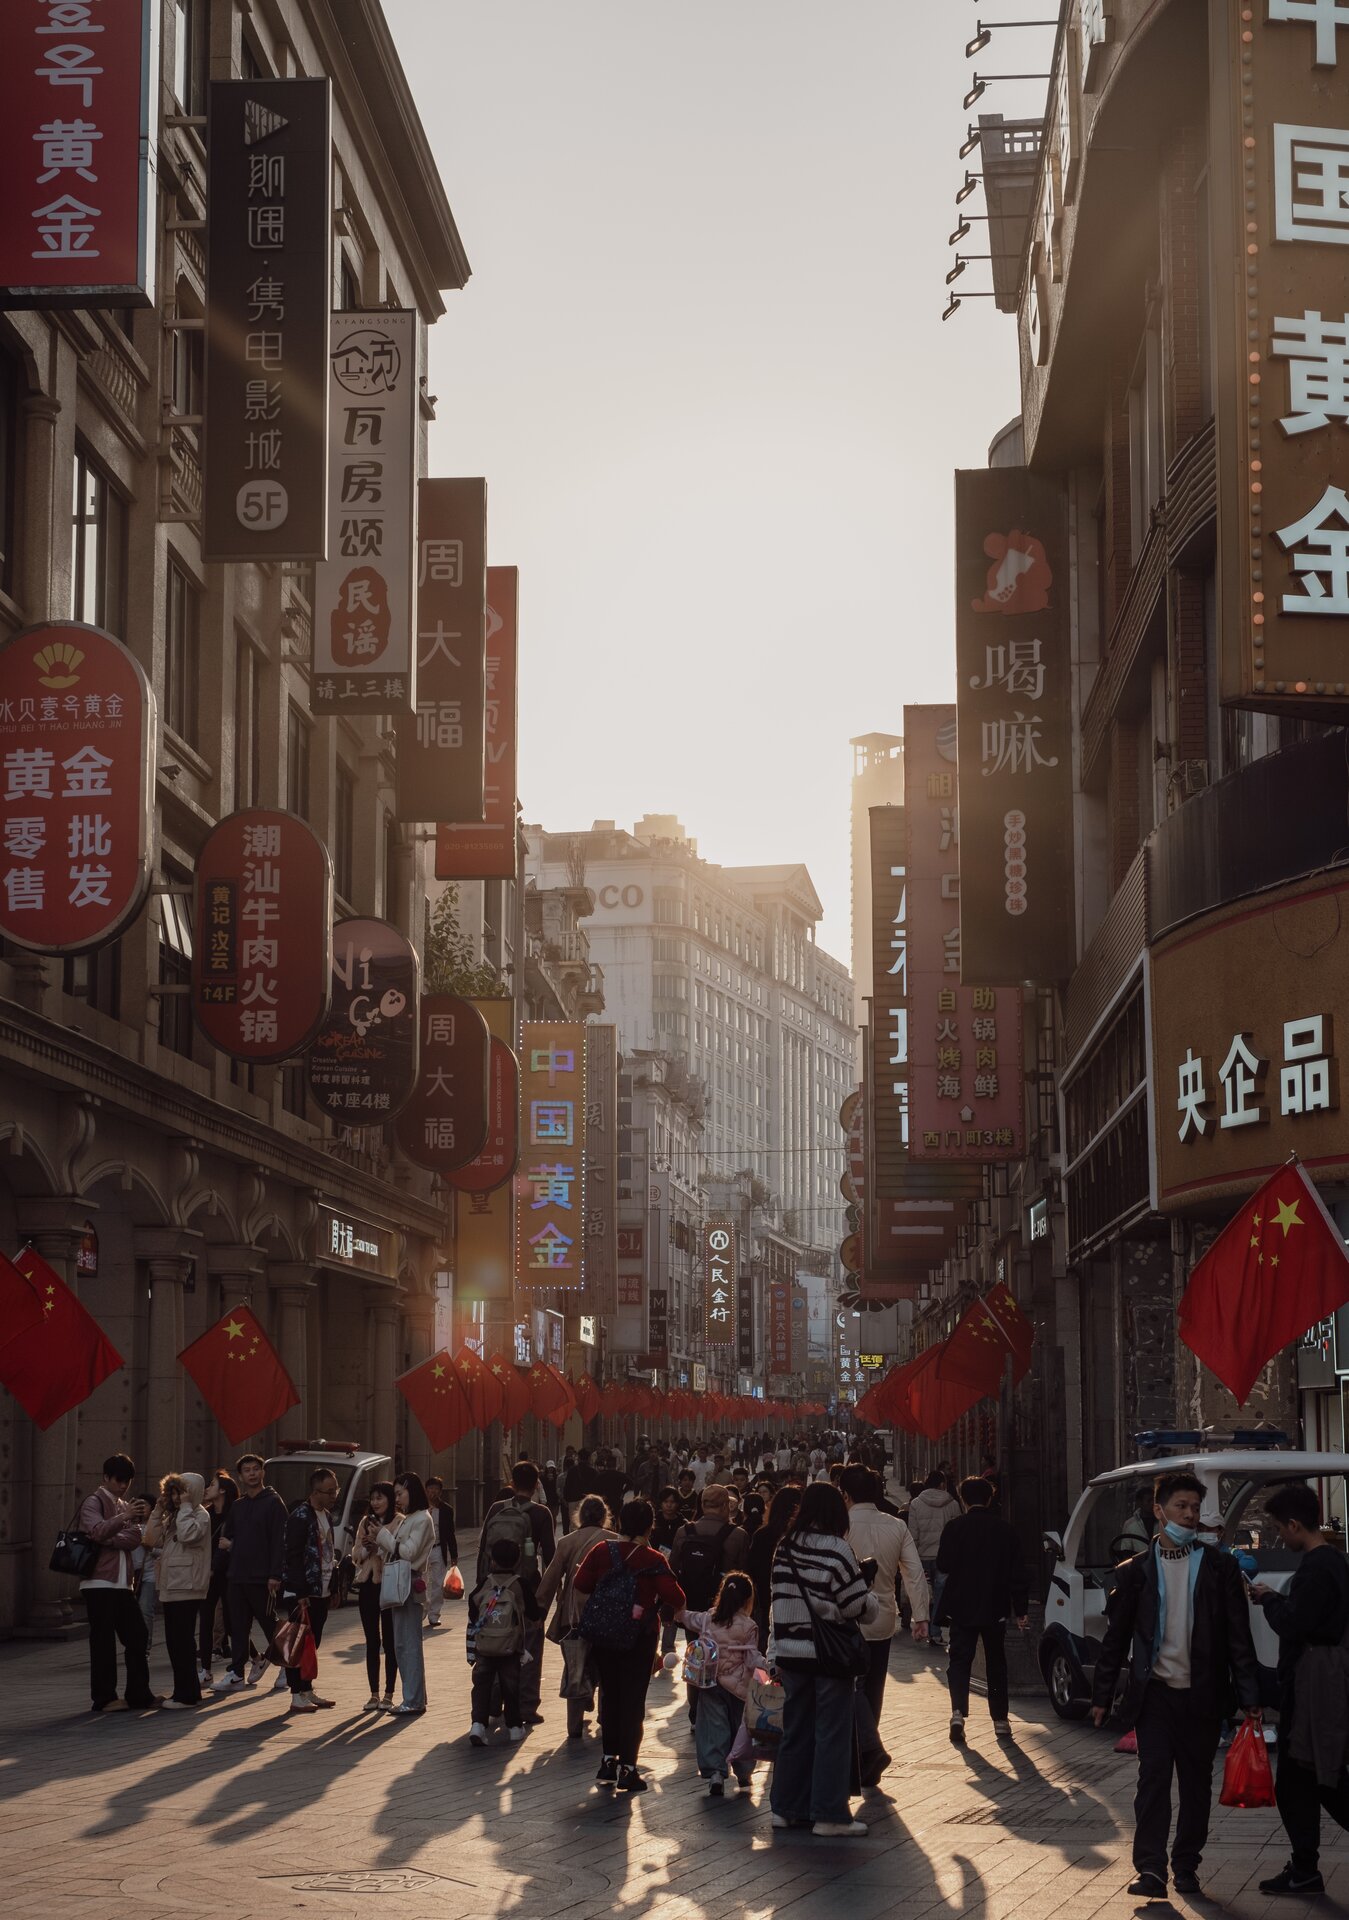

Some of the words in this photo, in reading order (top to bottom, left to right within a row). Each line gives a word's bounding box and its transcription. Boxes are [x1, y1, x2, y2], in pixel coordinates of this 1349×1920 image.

[243, 492, 283, 521] 5F
[339, 406, 385, 557] 瓦房颂
[342, 579, 380, 655] 民谣
[417, 539, 464, 749] 周大福
[0, 692, 124, 722] 水贝壹号黄金
[316, 680, 406, 699] 请上三楼
[970, 637, 1058, 778] 喝嘛
[20, 723, 34, 732] BEI
[50, 722, 70, 731] HAO
[73, 720, 105, 730] HUANG
[4, 746, 114, 800] 黄金
[590, 885, 644, 909] CO
[240, 824, 281, 1043] 潮汕牛肉火锅
[212, 986, 235, 1001] 4F
[327, 1091, 390, 1109] 本座4楼
[425, 1014, 454, 1149] 周大福
[527, 1041, 576, 1269] 中国黄金
[924, 1130, 1013, 1149] 西门町3楼
[709, 1254, 731, 1322] 人民金行
